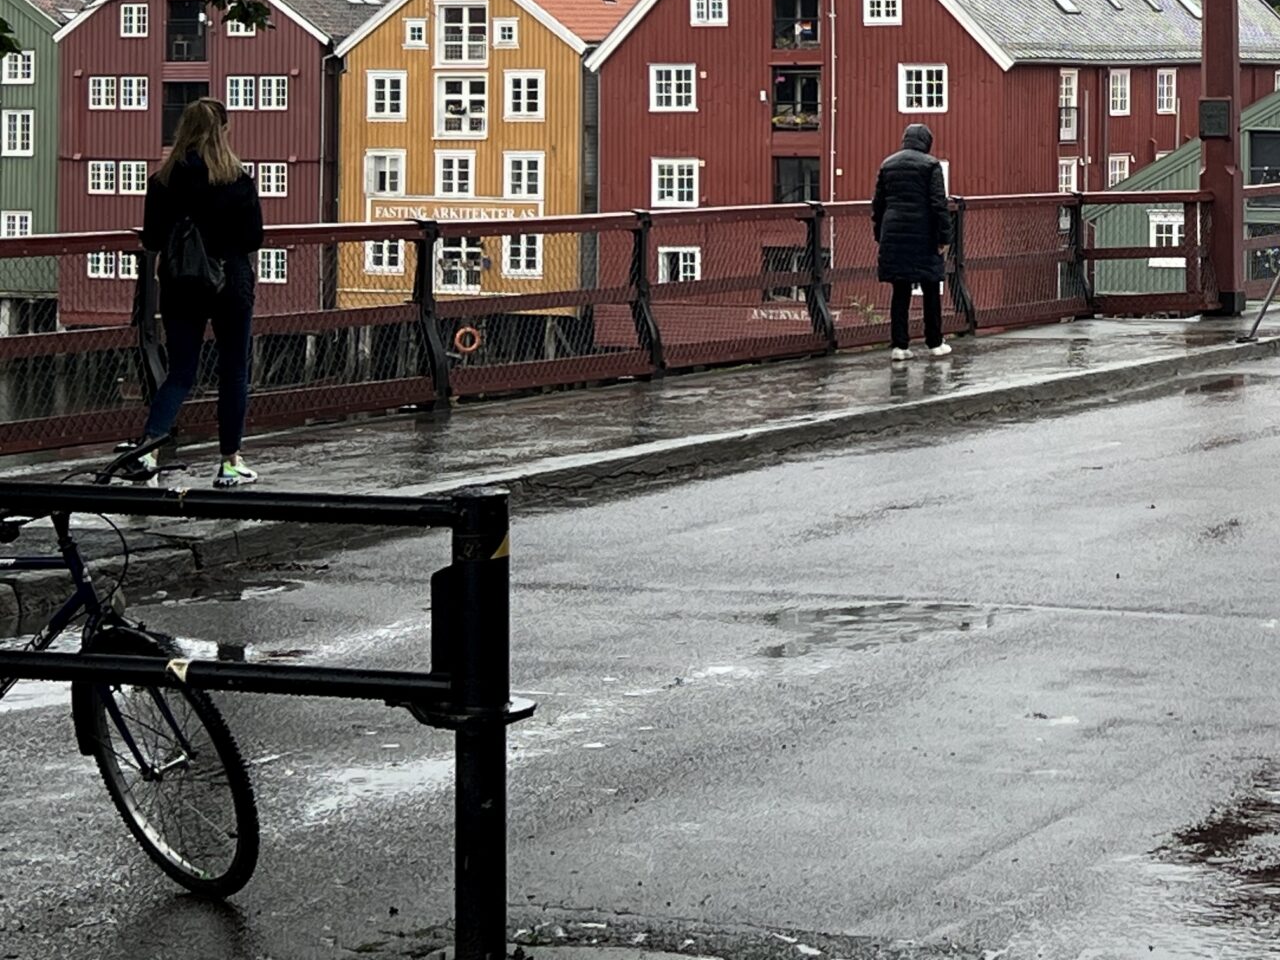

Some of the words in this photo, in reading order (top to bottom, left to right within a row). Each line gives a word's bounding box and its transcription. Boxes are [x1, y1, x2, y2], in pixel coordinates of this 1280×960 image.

[375, 206, 427, 219] FASTING
[431, 207, 514, 219] ARKITEKTER
[519, 208, 535, 218] AS
